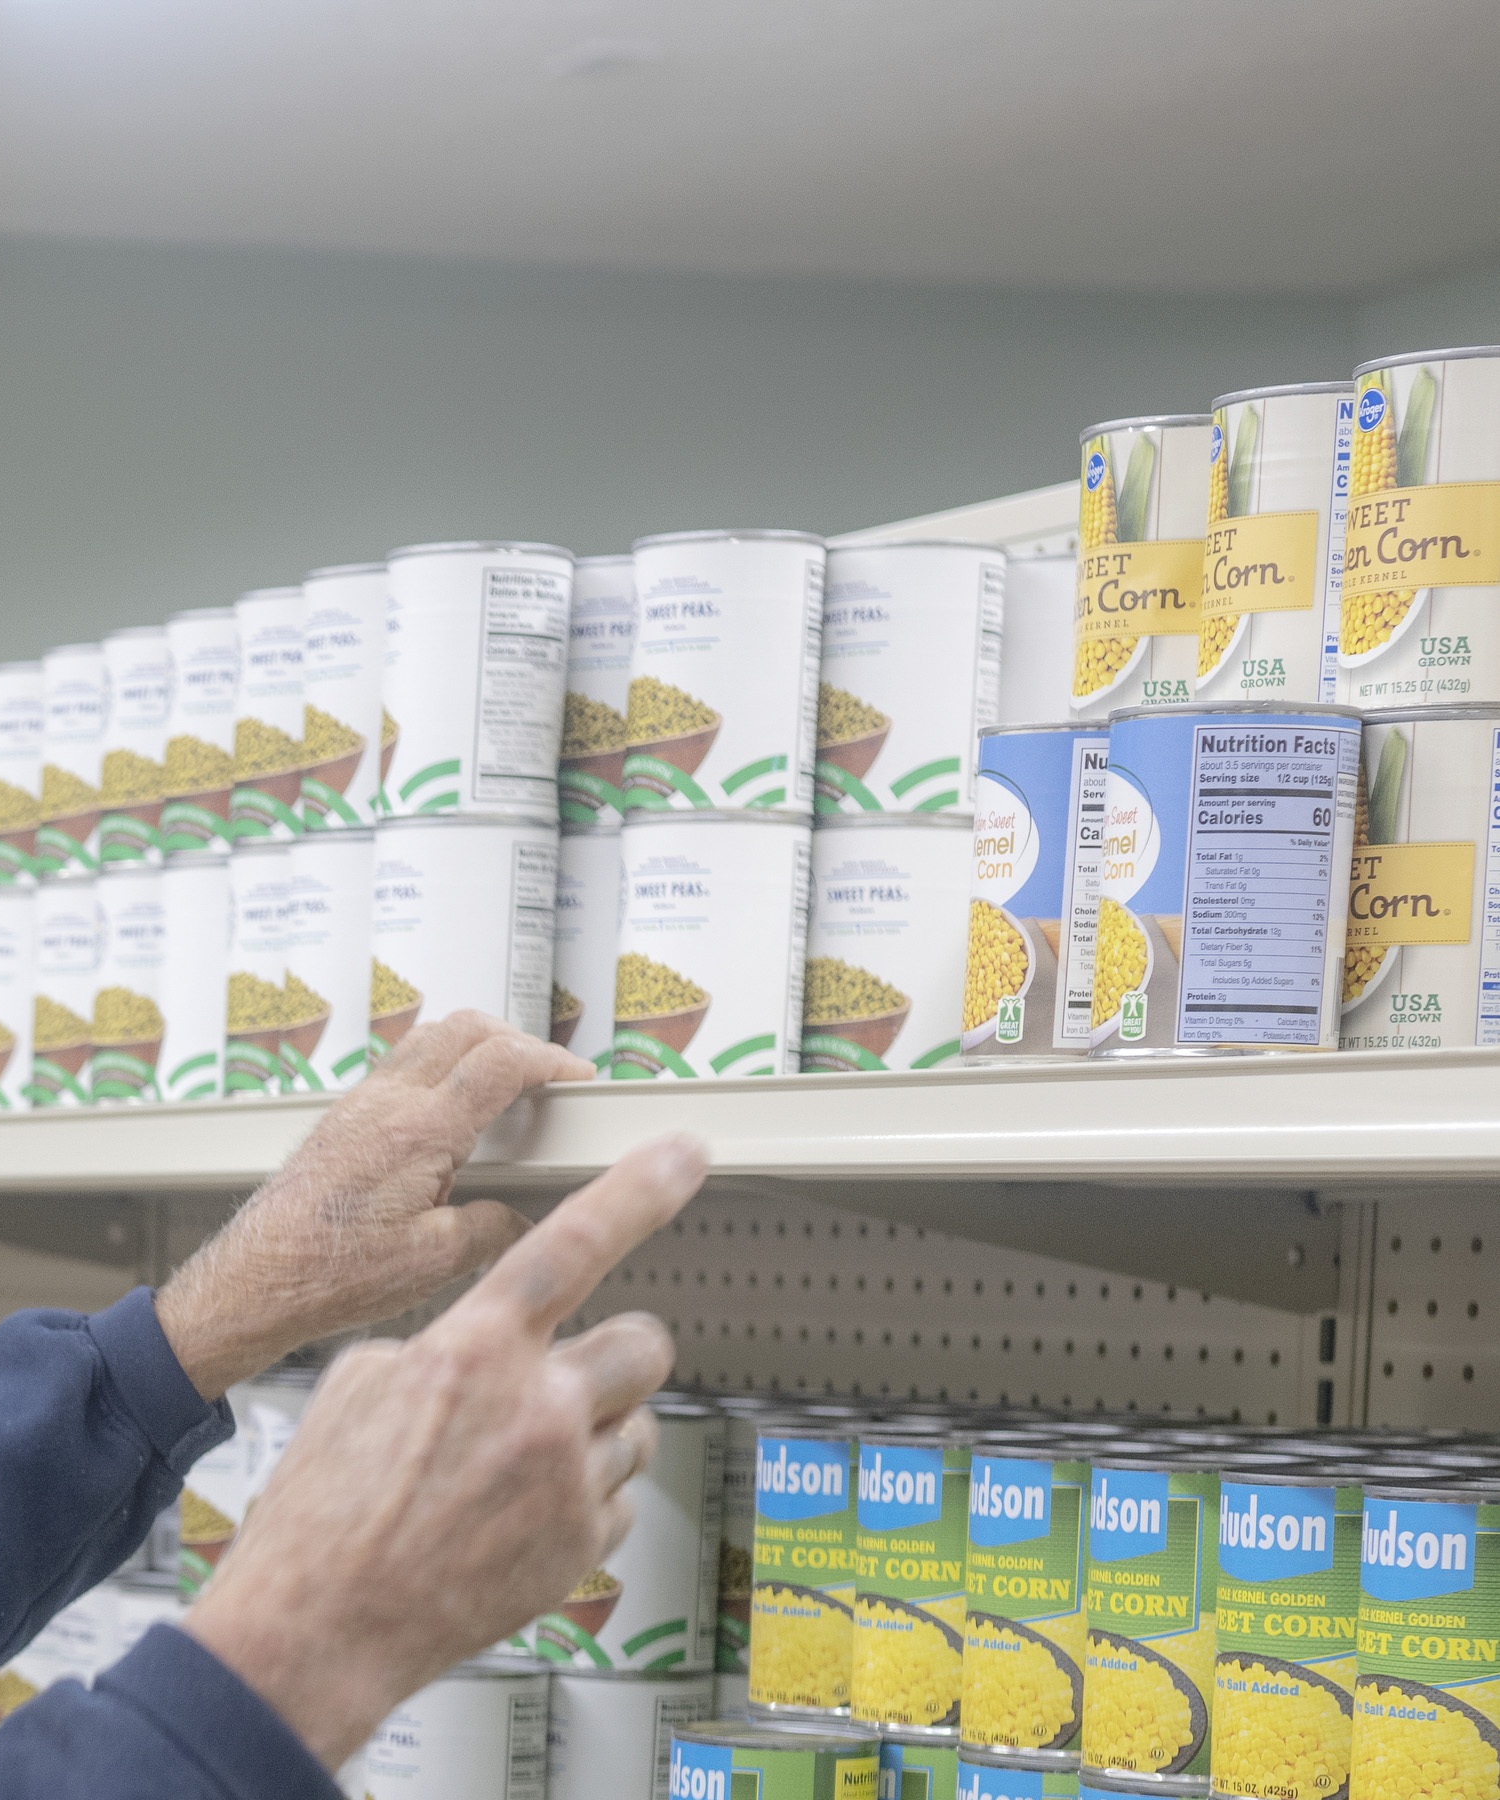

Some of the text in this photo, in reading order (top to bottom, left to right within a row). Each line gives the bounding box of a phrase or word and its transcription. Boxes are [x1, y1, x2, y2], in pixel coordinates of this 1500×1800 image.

[1360, 571, 1407, 584] KERNEL
[1420, 637, 1471, 654] USA
[1242, 659, 1286, 677] USA
[1418, 656, 1471, 667] GROWN
[1143, 680, 1189, 696] USA
[1240, 678, 1286, 688] GROWN
[1360, 680, 1470, 696] NET WT 15.25 OZ (432g)
[1202, 735, 1335, 755] Nutrition Facts
[1200, 761, 1223, 770] about
[1226, 761, 1238, 769] 3.5
[1241, 762, 1274, 772] servings
[1277, 763, 1289, 771] per
[1200, 774, 1333, 787] Serving size 1/2 cup (125g)
[1199, 799, 1229, 807] Amount
[1248, 800, 1276, 808] serving
[987, 812, 1015, 830] Sweet
[1111, 806, 1138, 825] Sweet
[1198, 808, 1331, 826] Calories 60
[978, 860, 1012, 879] Corn
[1215, 927, 1268, 935] Carbohydrate
[1201, 943, 1223, 951] Dietary
[1219, 960, 1242, 968] Sugars
[1392, 994, 1441, 1011] USA
[1000, 1021, 1019, 1030] GREAT
[1123, 1019, 1142, 1028] GREAT
[1390, 1013, 1441, 1023] GROWN
[1349, 1037, 1404, 1048] WT 15.25 OZ
[971, 1465, 1044, 1520] udson
[885, 1558, 962, 1583] CORN
[999, 1557, 1043, 1571] GOLDEN
[992, 1576, 1071, 1600] CORN
[1115, 1573, 1160, 1587] GOLDEN
[1110, 1592, 1188, 1617] CORN
[1232, 1589, 1325, 1607] KERNEL GOLDEN
[1264, 1613, 1357, 1639] CORN
[1370, 1610, 1465, 1628] KERNEL GOLDEN
[1402, 1635, 1499, 1662] CORN
[1227, 1679, 1299, 1696] Salt Added
[1364, 1701, 1436, 1721] Salt Added
[1263, 1783, 1298, 1799] (425g)
